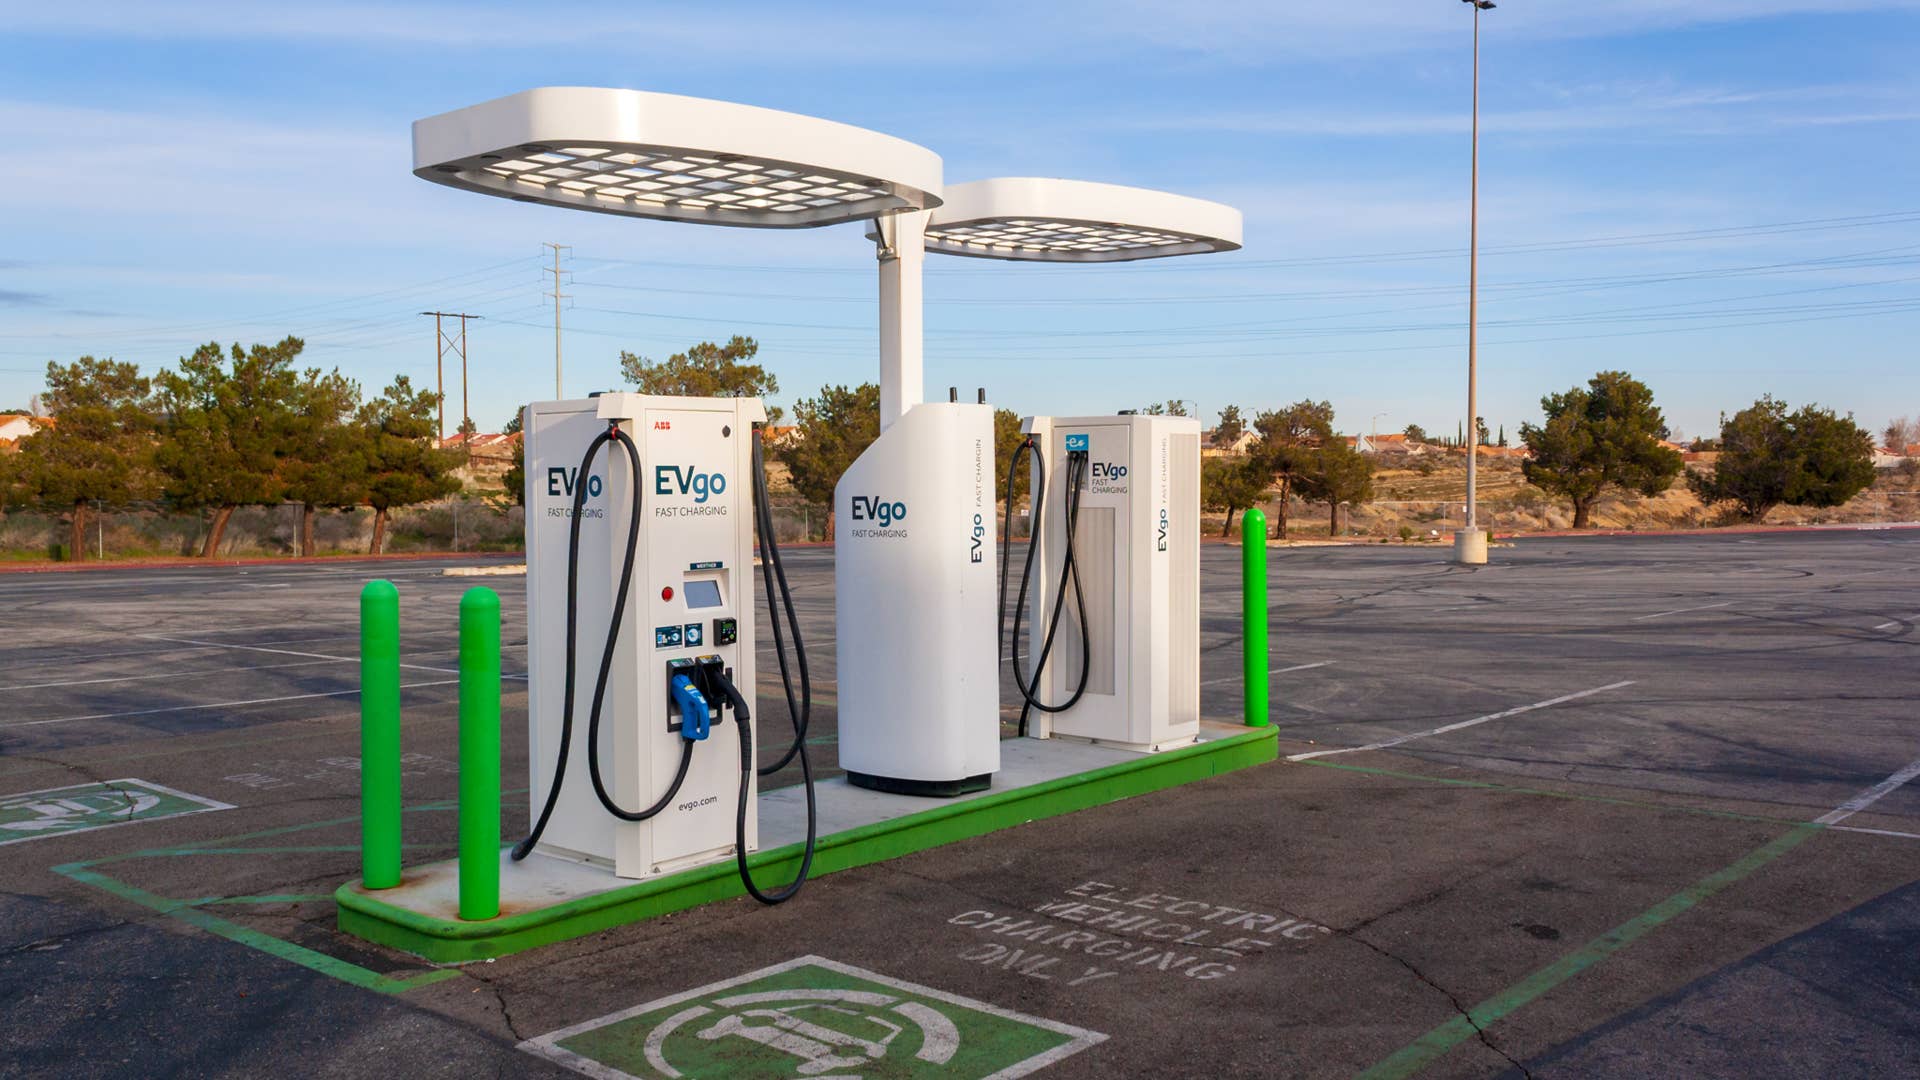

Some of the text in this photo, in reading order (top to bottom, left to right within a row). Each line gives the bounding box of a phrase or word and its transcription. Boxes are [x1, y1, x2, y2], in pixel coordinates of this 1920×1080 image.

[654, 421, 671, 430] ABB
[655, 465, 726, 503] EVgo
[1091, 478, 1108, 486] FAST
[1092, 462, 1128, 481] EVgo
[1091, 486, 1128, 494] CHARGING
[547, 507, 564, 517] FAST
[655, 505, 727, 517] FAST CHARGING
[851, 495, 907, 528] EVgo
[851, 529, 908, 538] FAST CHARGING
[971, 513, 985, 563] EVgo
[1158, 508, 1168, 552] EVgo
[678, 796, 718, 812] evgo.com
[1063, 880, 1332, 940] ELECTRIC
[1034, 899, 1273, 957] VEHICLE
[946, 909, 1237, 981] CHARGING
[957, 942, 1120, 986] ONLY
